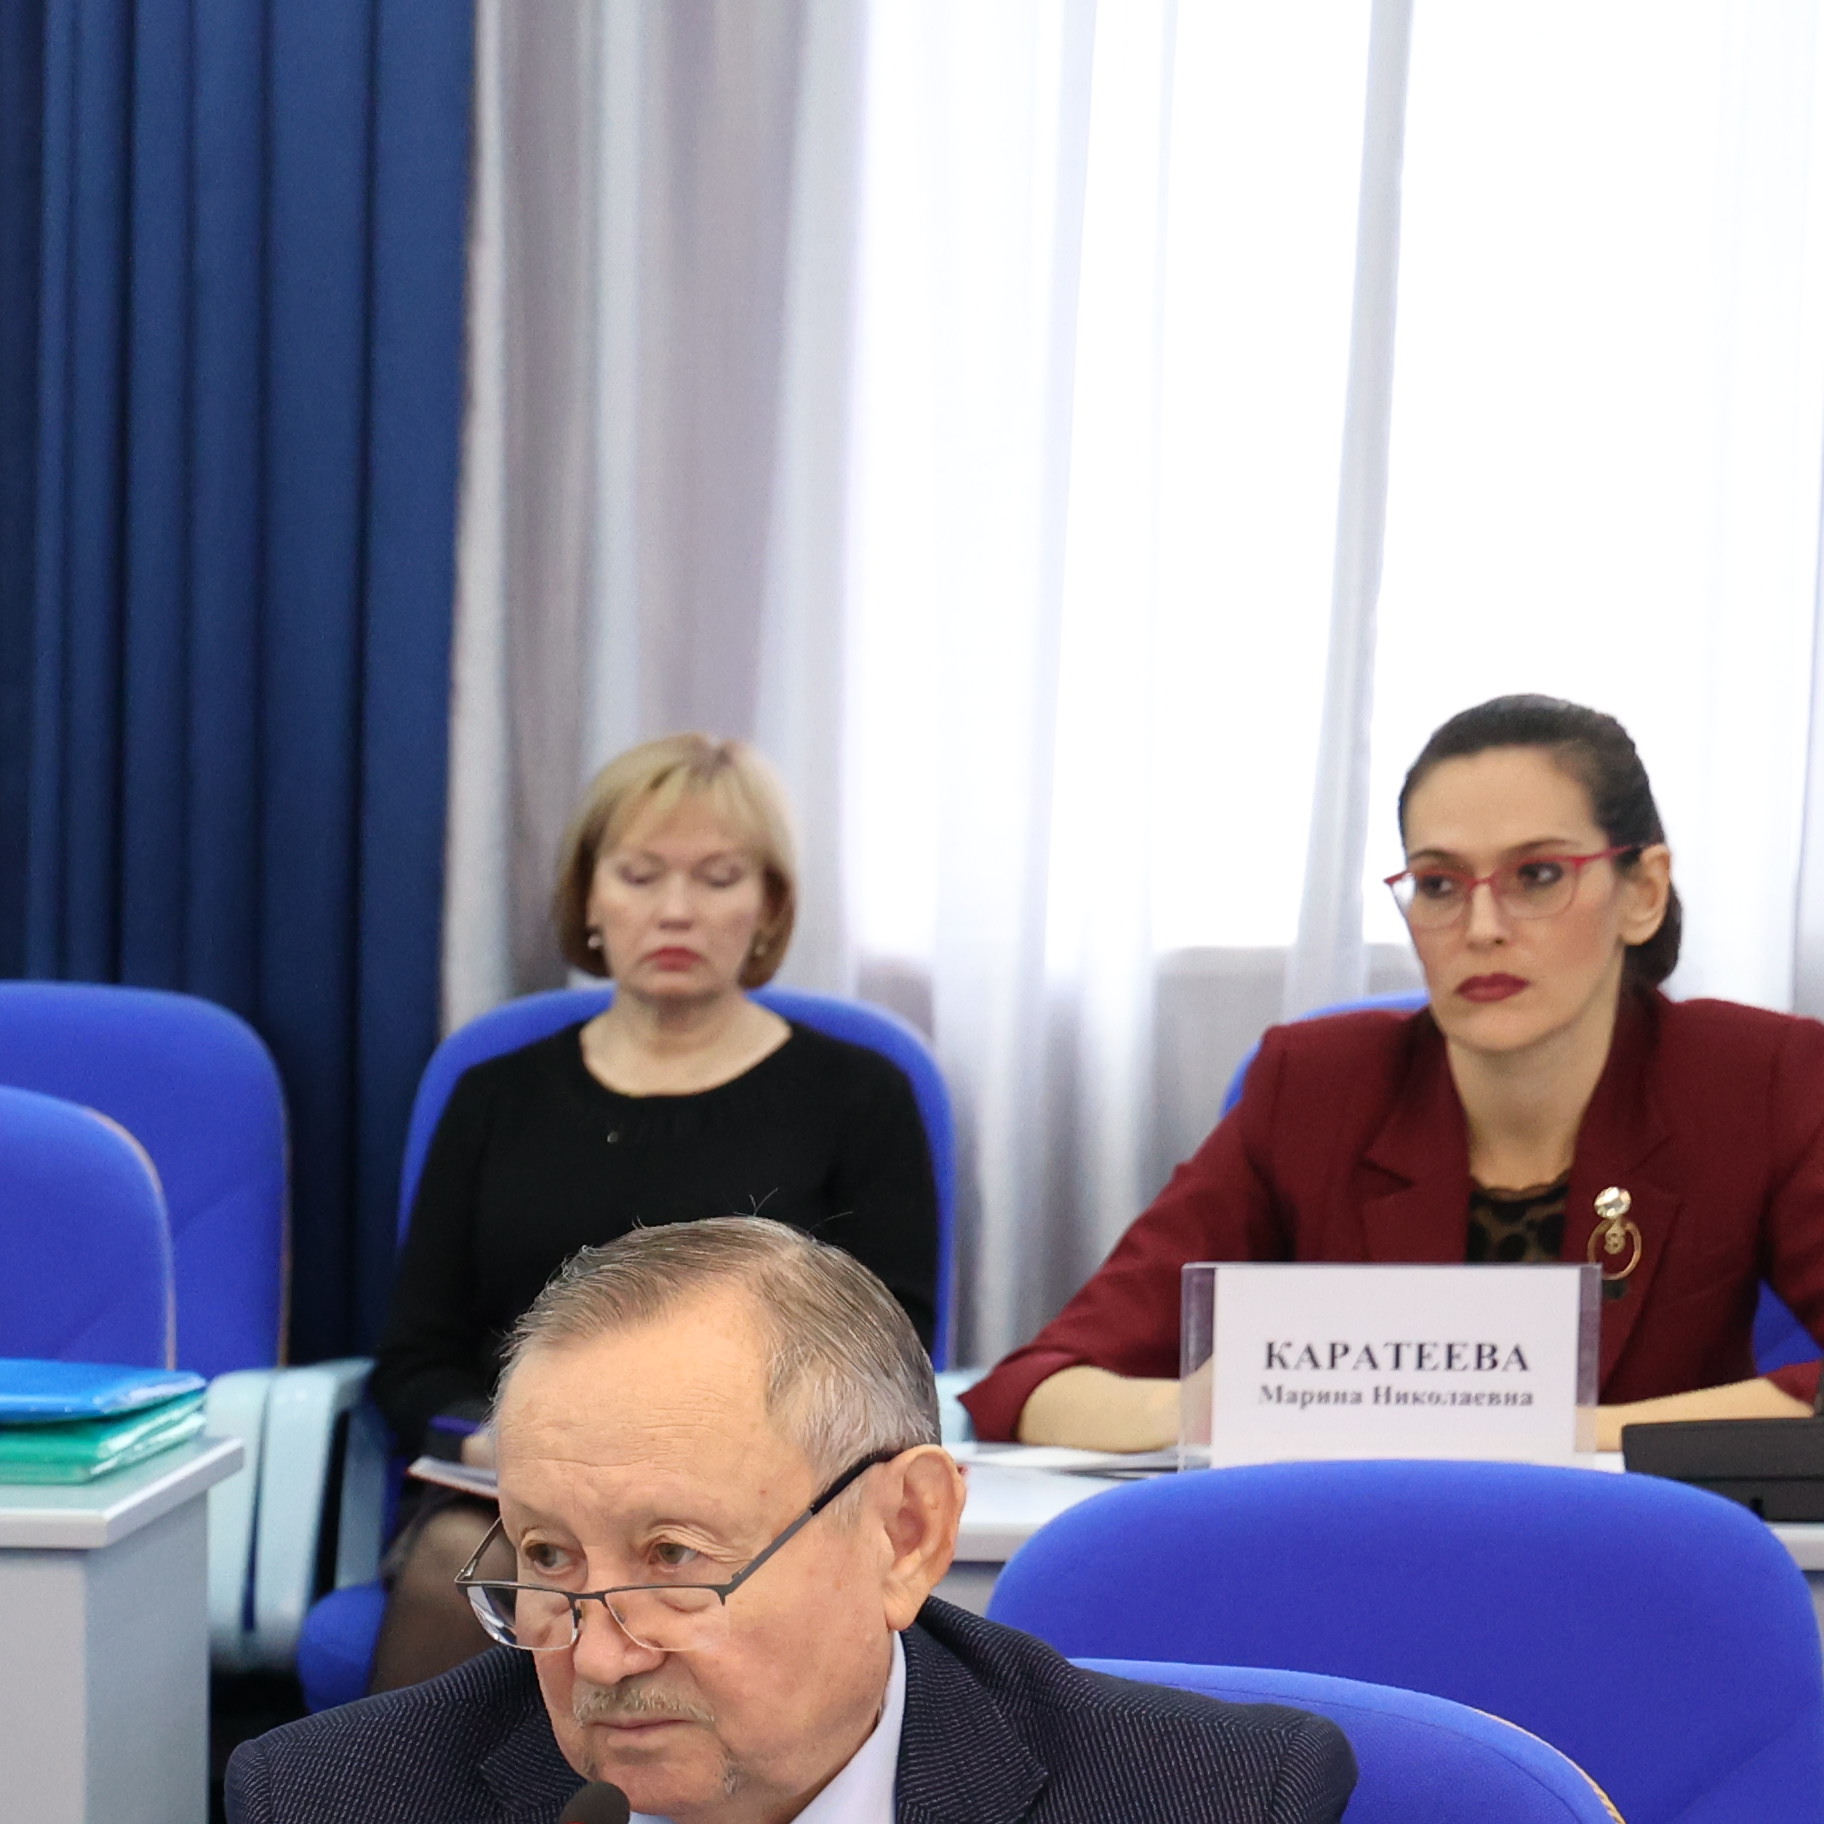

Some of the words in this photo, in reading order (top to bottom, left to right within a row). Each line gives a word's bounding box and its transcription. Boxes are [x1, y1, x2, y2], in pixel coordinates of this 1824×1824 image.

[1263, 1340, 1531, 1373] КАРАТЕЕВА
[1259, 1383, 1364, 1410] Марина
[1371, 1384, 1535, 1408] Николаевна
